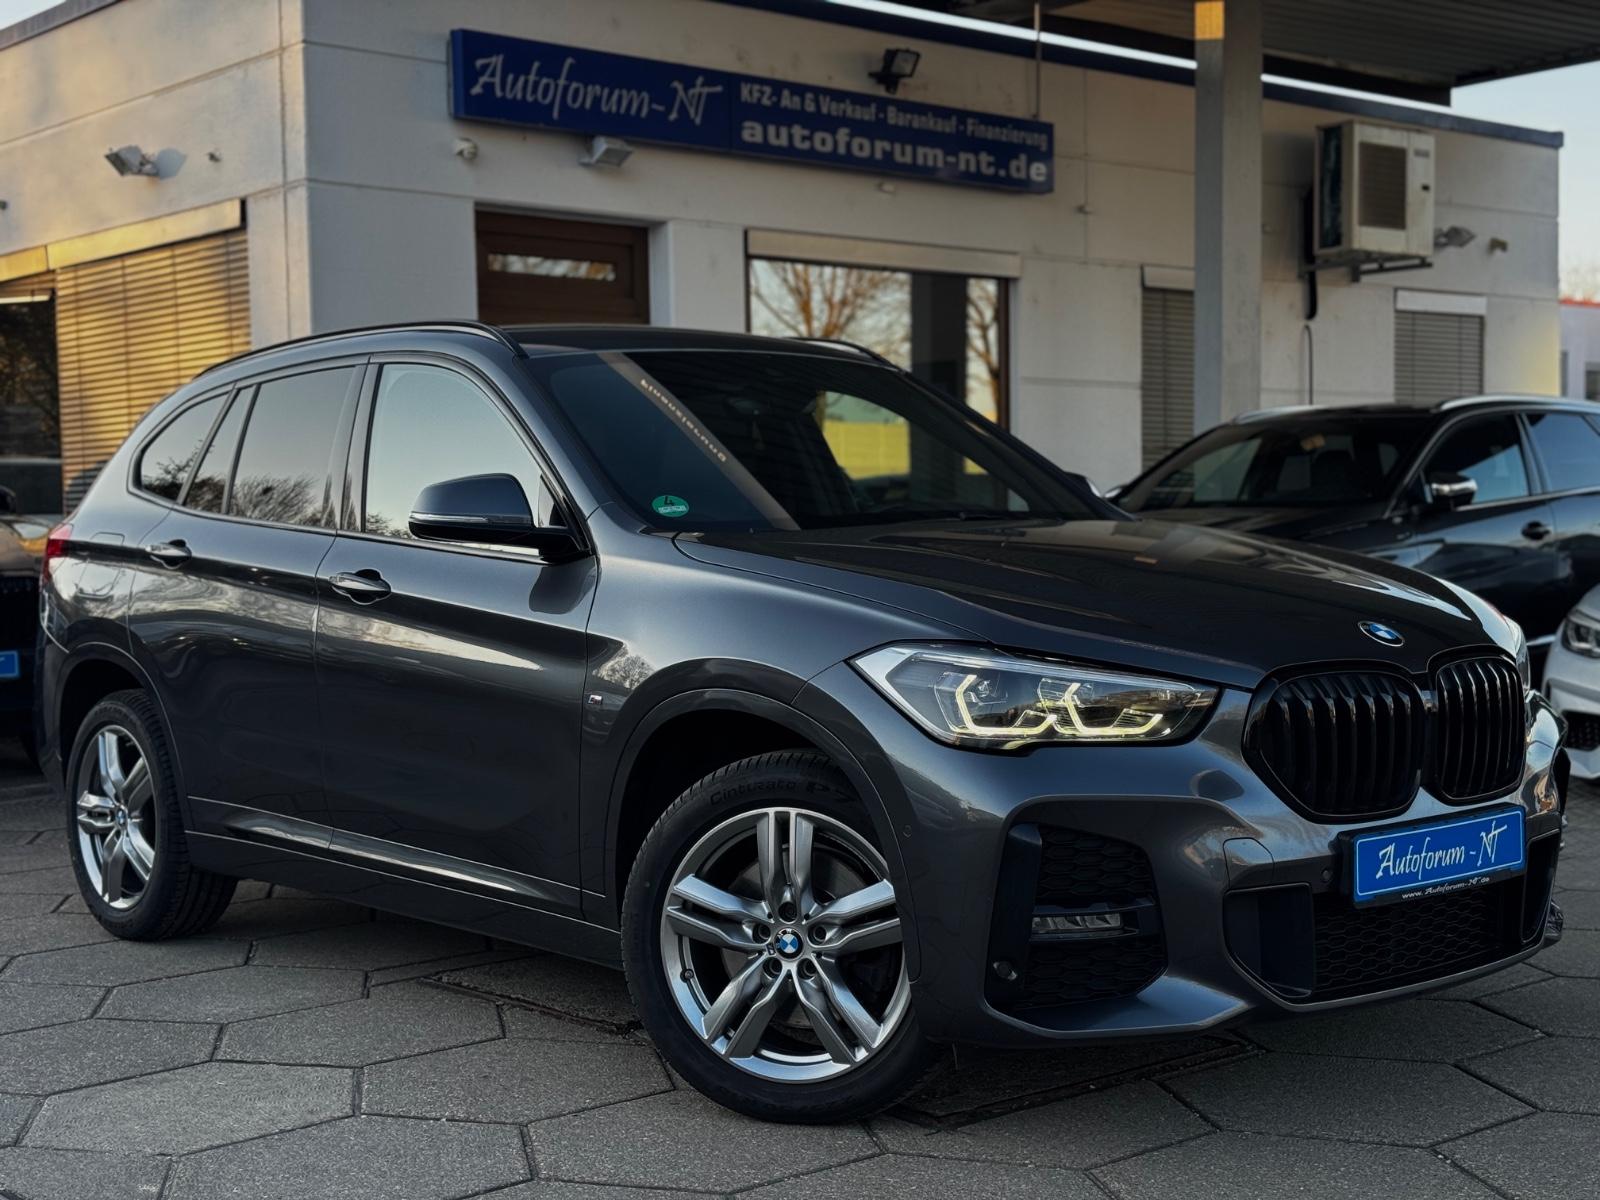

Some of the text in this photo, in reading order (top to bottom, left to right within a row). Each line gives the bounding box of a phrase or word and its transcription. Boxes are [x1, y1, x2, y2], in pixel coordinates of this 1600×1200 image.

[469, 54, 723, 126] Autoforum-NT
[780, 88, 801, 111] An
[803, 93, 817, 113] &
[818, 94, 877, 122] Verkauf
[886, 106, 957, 134] Barankauf
[966, 118, 1048, 152] Finanzierung
[741, 120, 1048, 183] autoforum-nt.de
